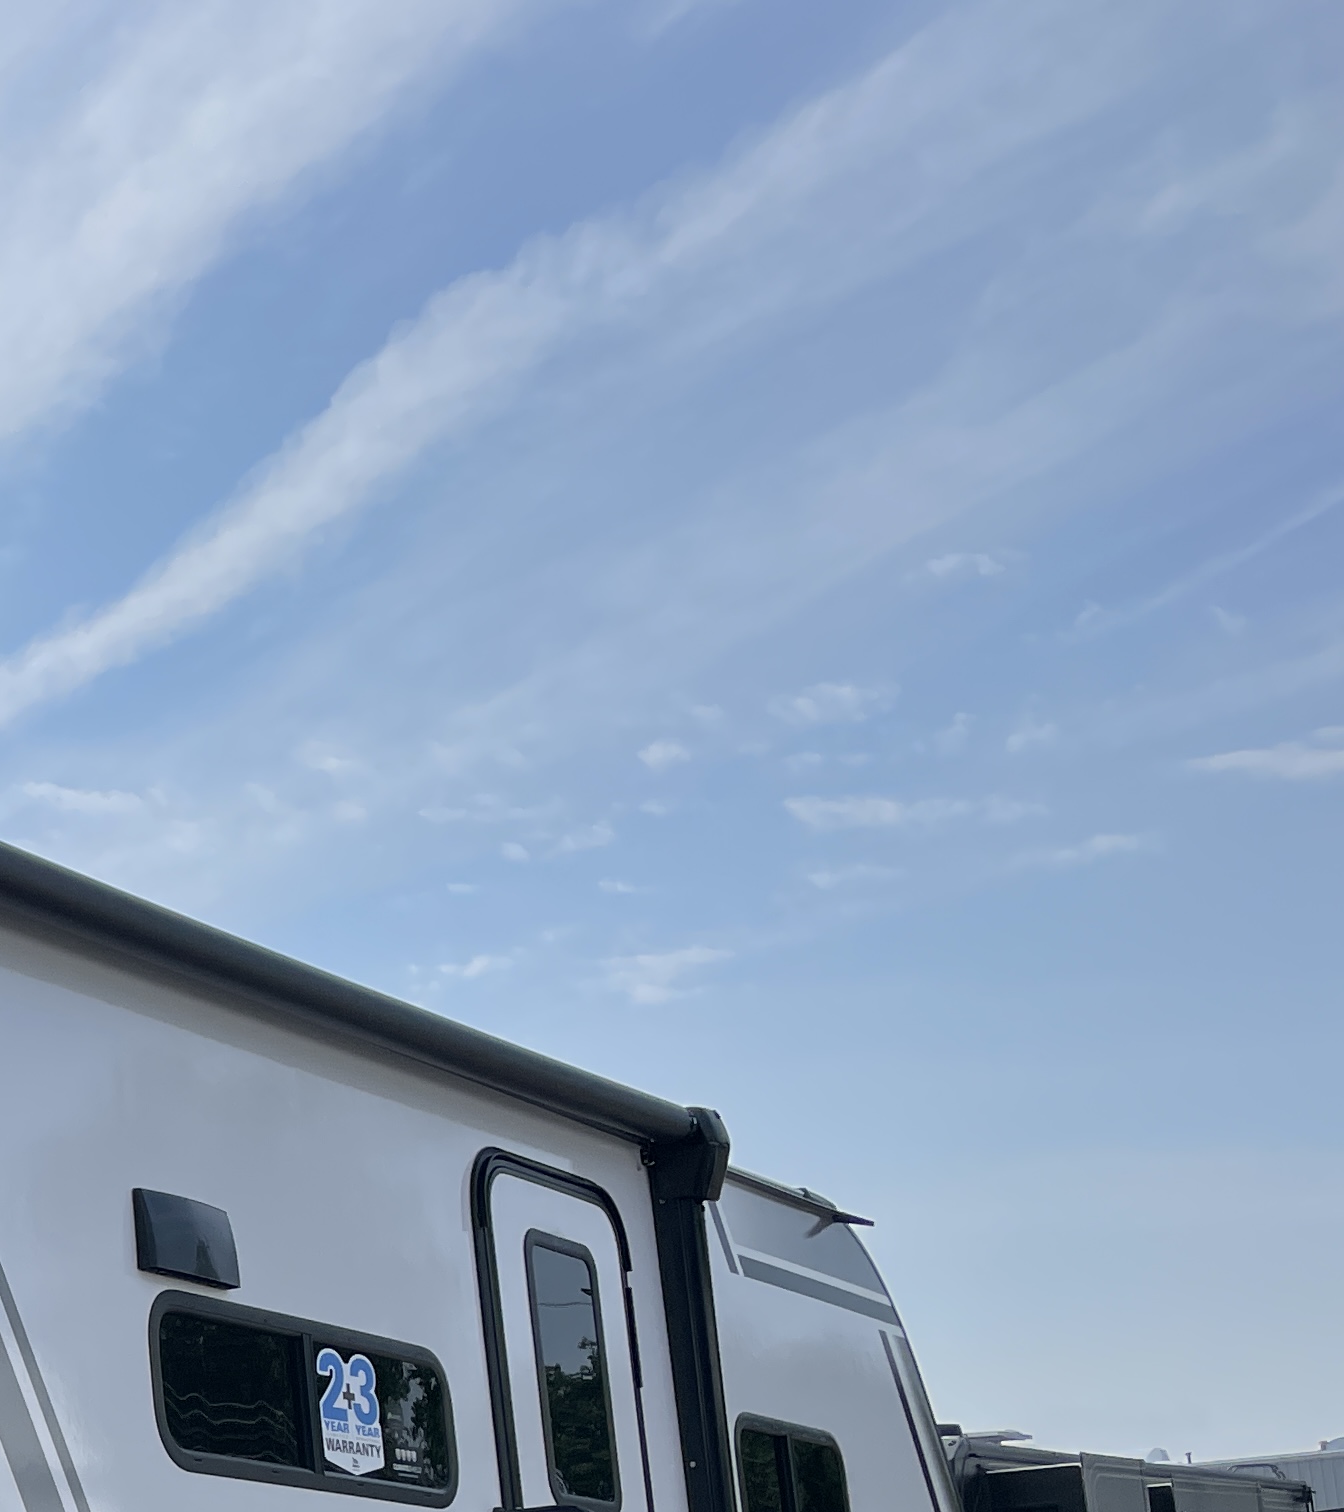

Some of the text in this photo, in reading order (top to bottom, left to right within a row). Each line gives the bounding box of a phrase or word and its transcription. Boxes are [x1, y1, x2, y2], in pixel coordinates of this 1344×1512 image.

[324, 1419, 381, 1439] YEAR YEAR
[325, 1437, 382, 1459] WARRANTY
